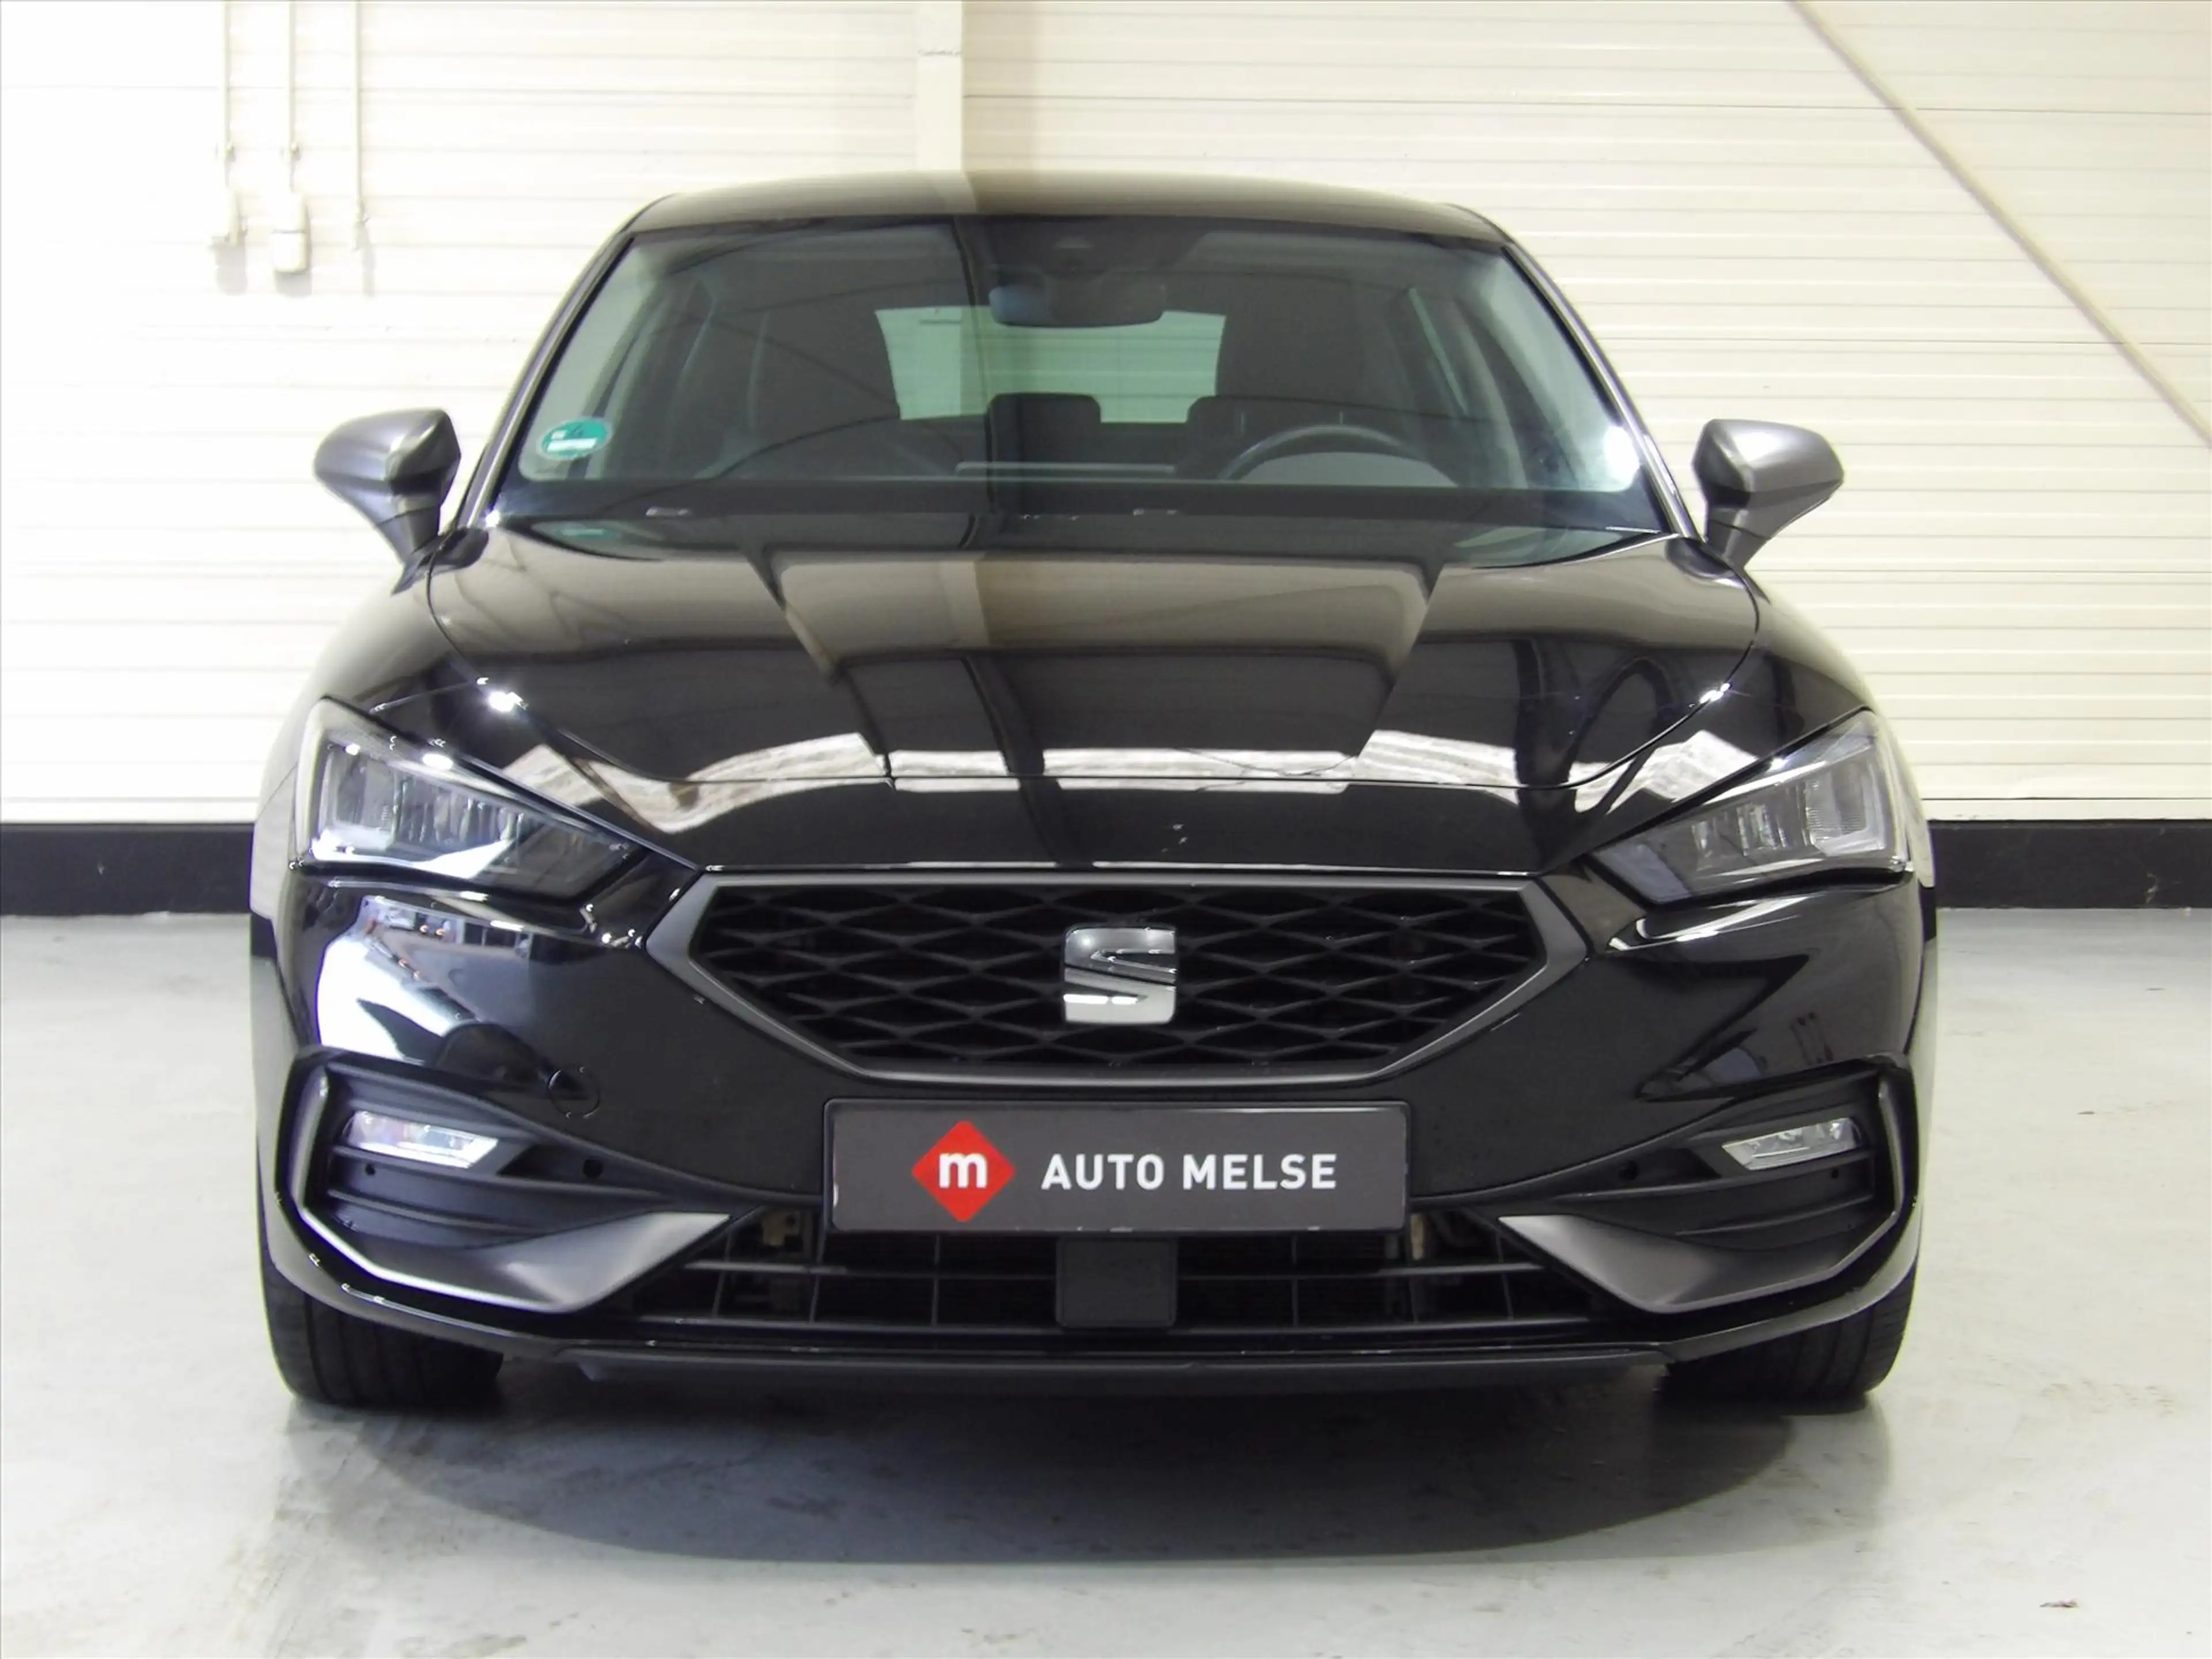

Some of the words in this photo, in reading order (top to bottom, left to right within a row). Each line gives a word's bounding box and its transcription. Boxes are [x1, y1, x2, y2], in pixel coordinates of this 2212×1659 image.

[938, 1153, 988, 1188] m
[1040, 1153, 1165, 1190] AUTO
[1182, 1153, 1337, 1190] MELSE
